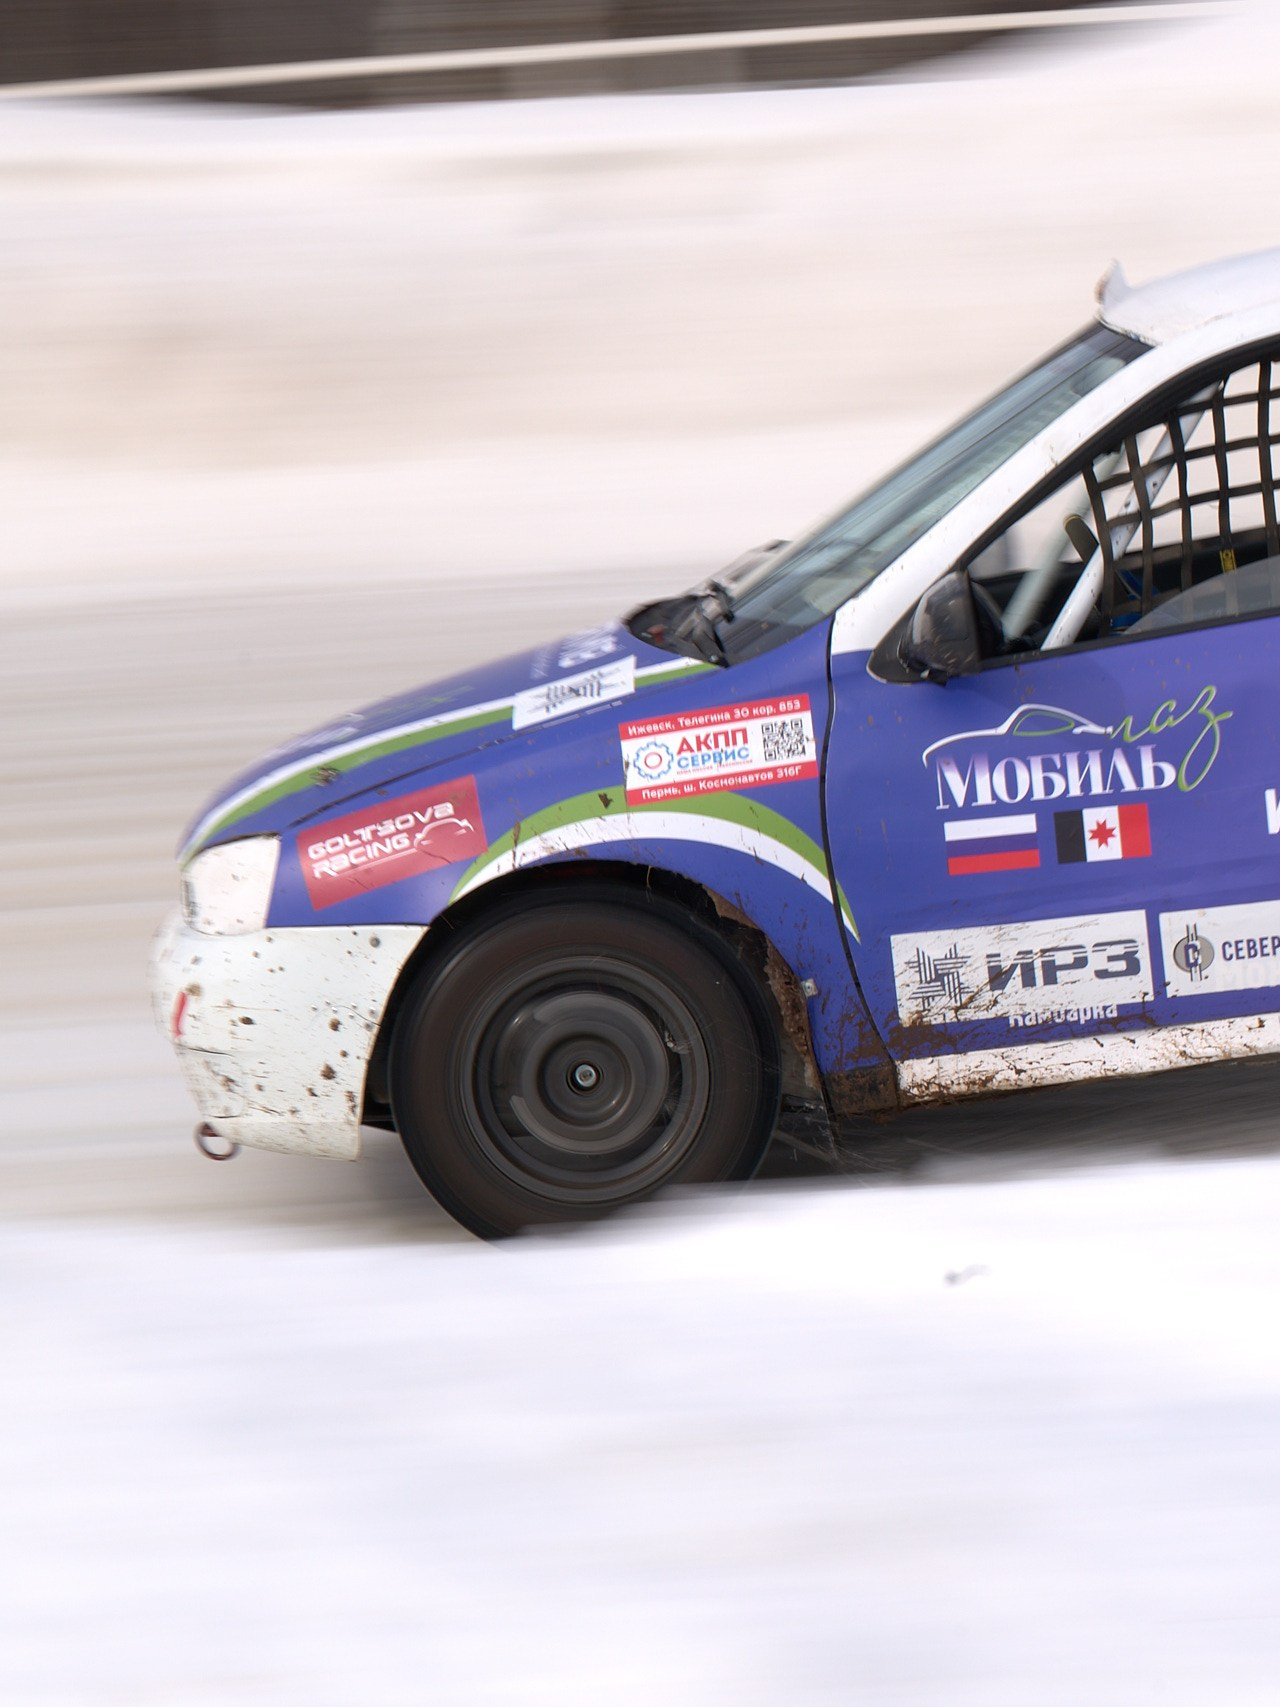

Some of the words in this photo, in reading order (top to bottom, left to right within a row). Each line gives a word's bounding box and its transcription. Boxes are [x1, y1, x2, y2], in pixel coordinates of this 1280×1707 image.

[677, 727, 749, 756] АКПП
[677, 746, 750, 769] СЕРВИС
[985, 938, 1143, 991] ИРЗ
